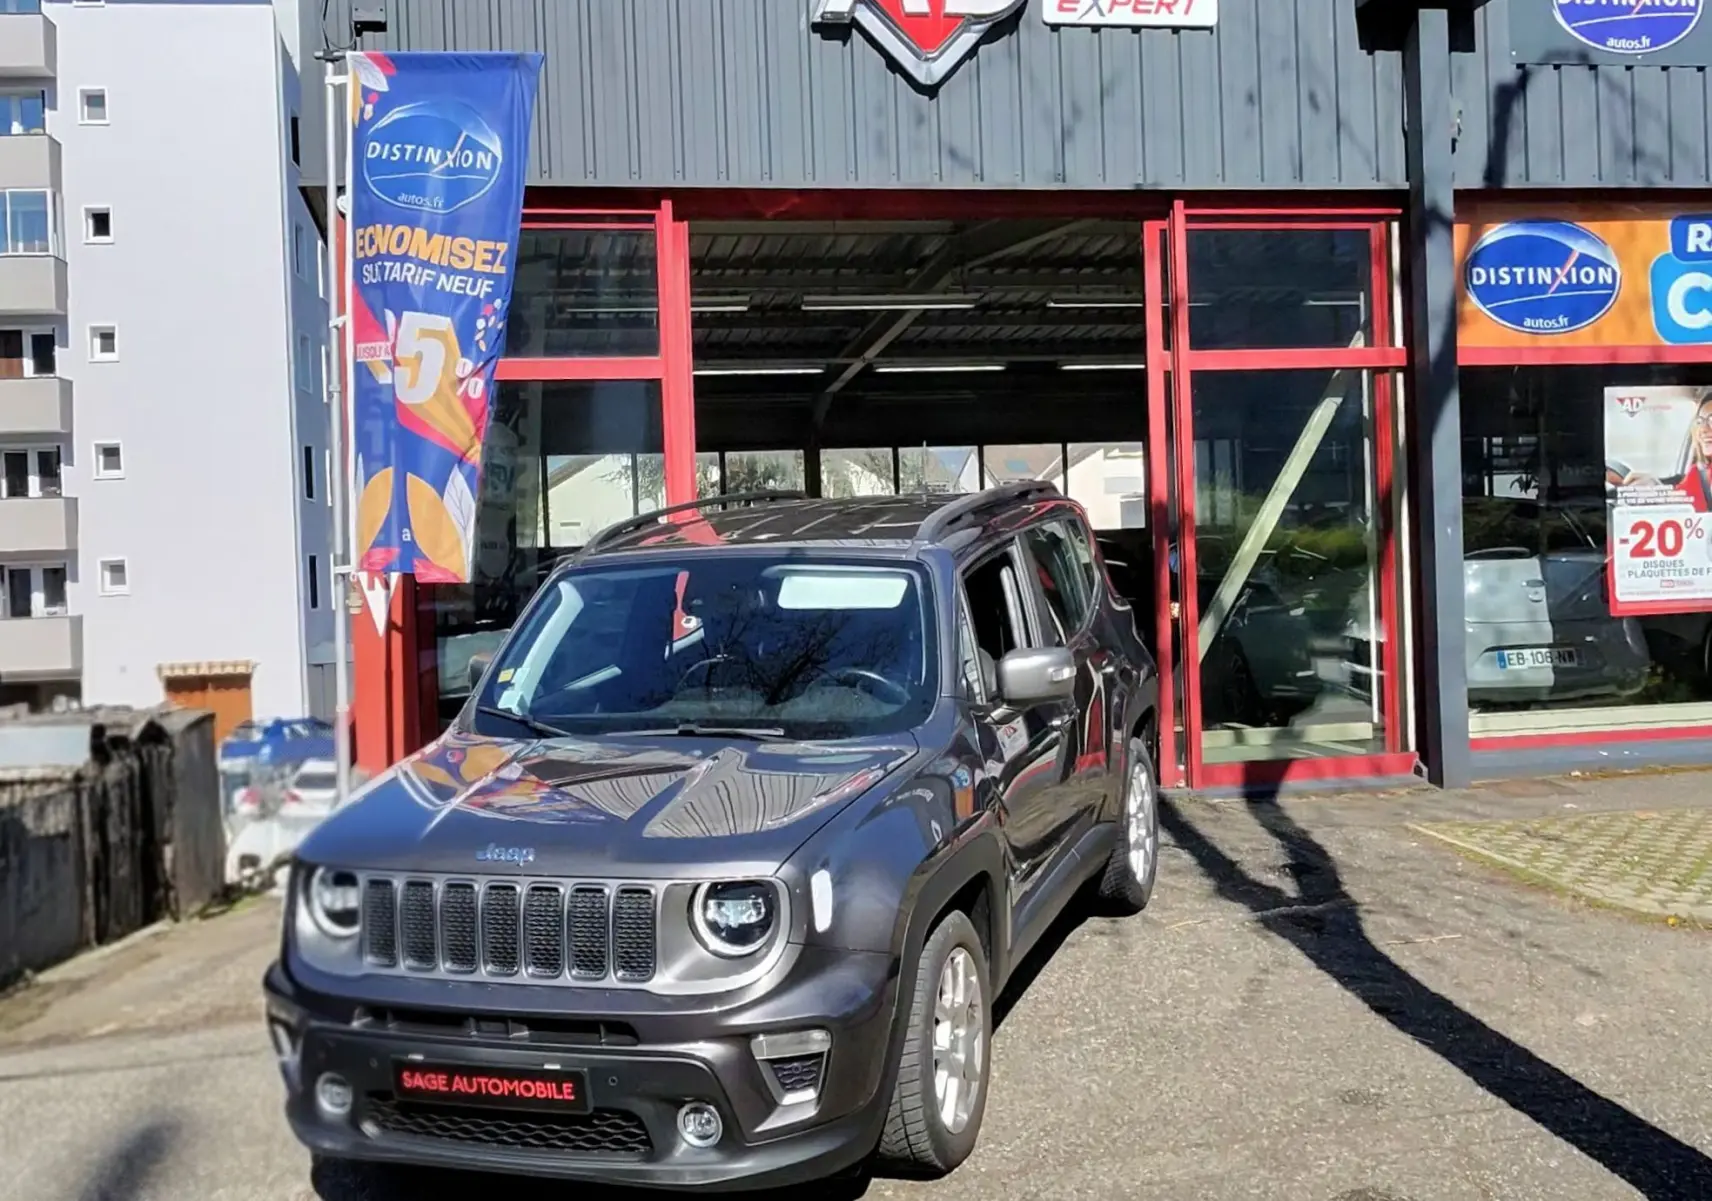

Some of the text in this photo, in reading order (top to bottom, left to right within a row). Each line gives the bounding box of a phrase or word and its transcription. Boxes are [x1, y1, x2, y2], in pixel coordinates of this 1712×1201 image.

[1606, 35, 1651, 49] autos.fr
[367, 141, 492, 170] DISTINXION
[397, 192, 444, 208] autos.fr
[382, 261, 437, 286] TARIF
[436, 273, 495, 299] NEUF
[1471, 266, 1613, 286] DISTINXION
[1523, 315, 1570, 329] autos.fr
[1628, 568, 1690, 579] PLAQUETTES
[1692, 567, 1704, 576] DE
[1643, 560, 1684, 569] DISQUES
[476, 842, 536, 868] Jeep
[402, 1071, 576, 1100] SAGE AUTOMOBILE
